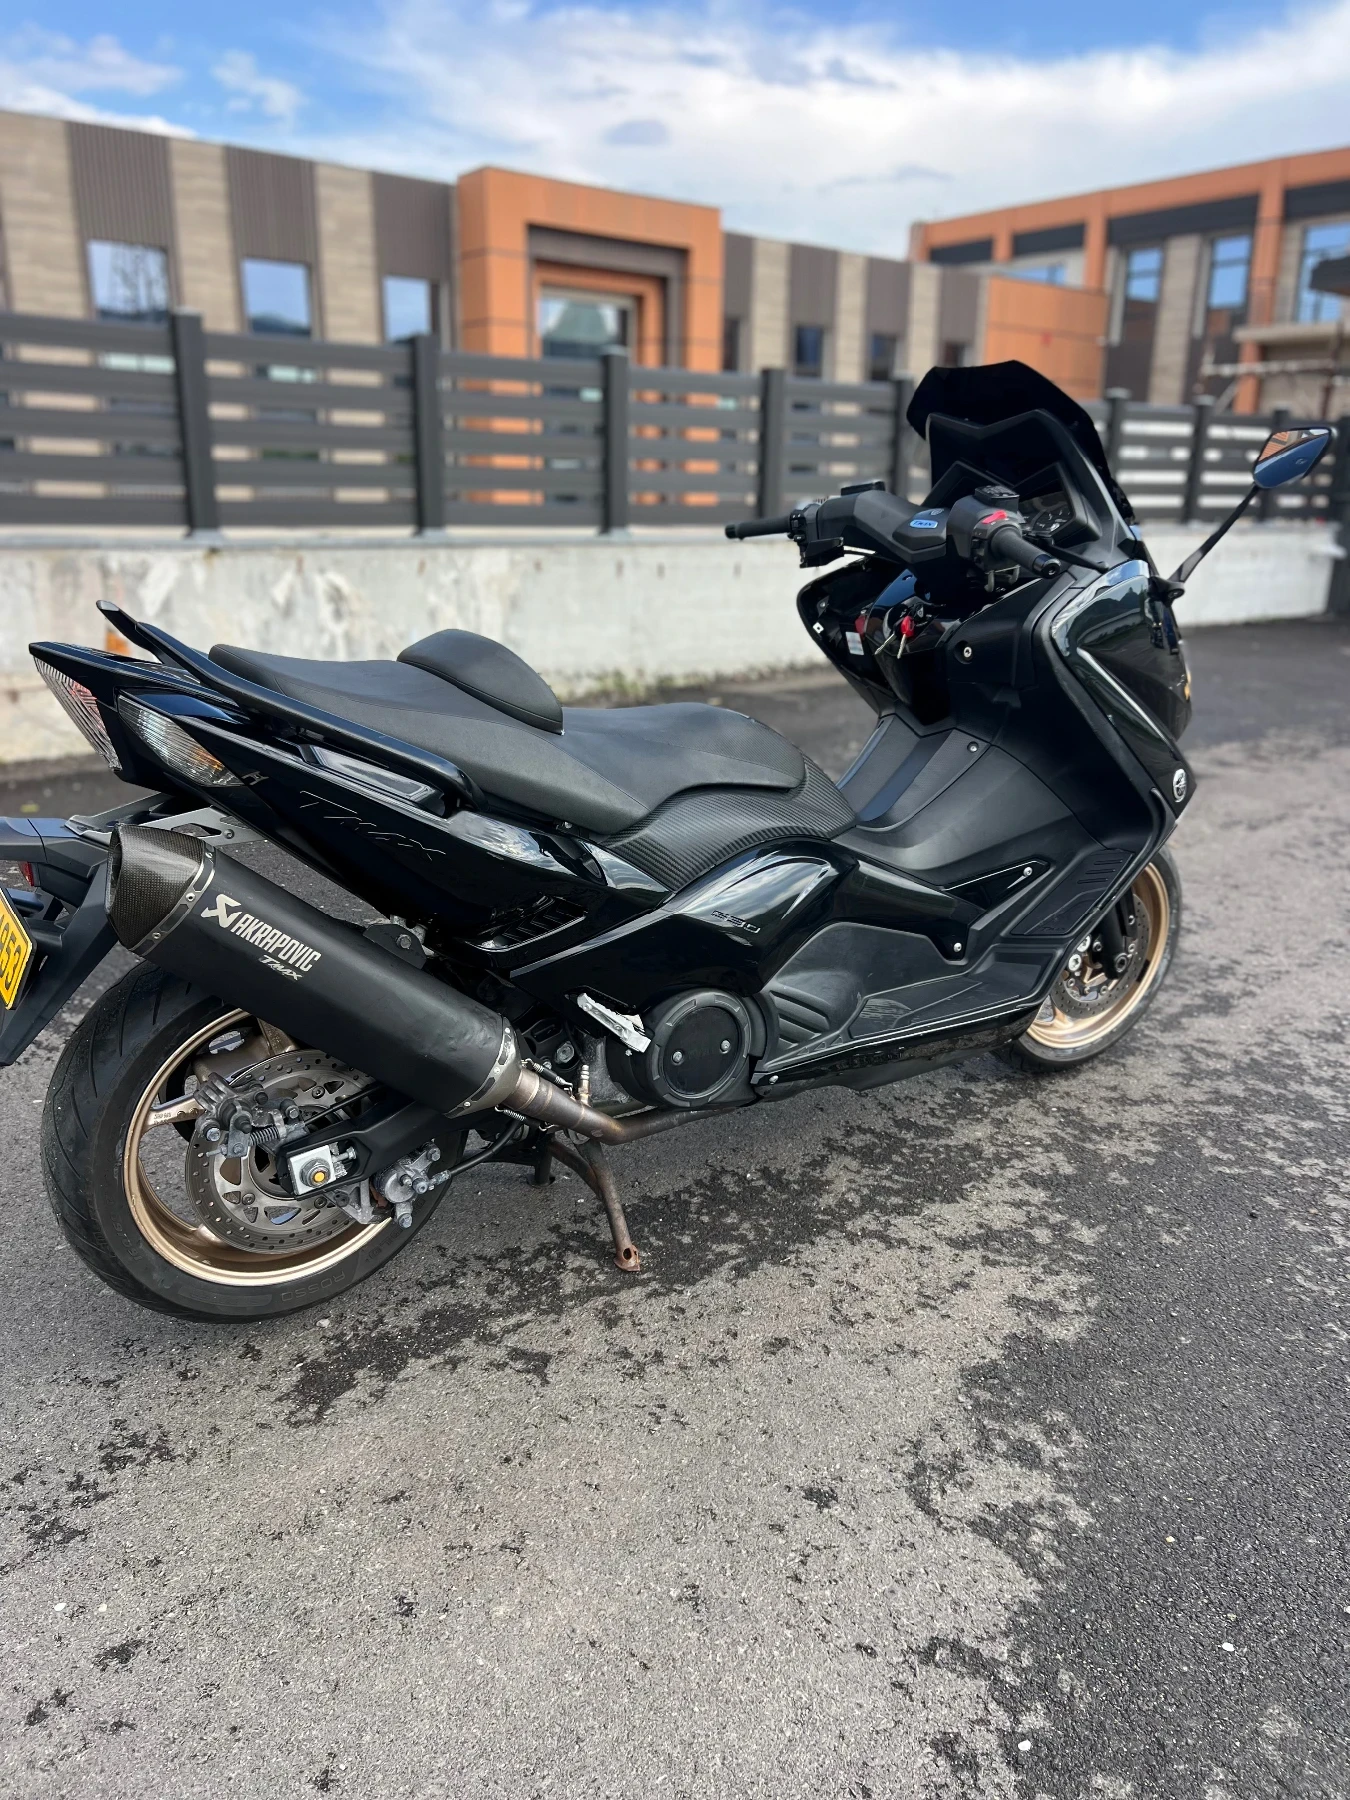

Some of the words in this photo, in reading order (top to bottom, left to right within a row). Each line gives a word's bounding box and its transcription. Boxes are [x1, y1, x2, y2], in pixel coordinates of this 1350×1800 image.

[0, 913, 21, 991] 953
[230, 913, 322, 972] AKRAPOVIC
[258, 954, 304, 981] TMAX
[281, 1270, 346, 1301] ROSSO
